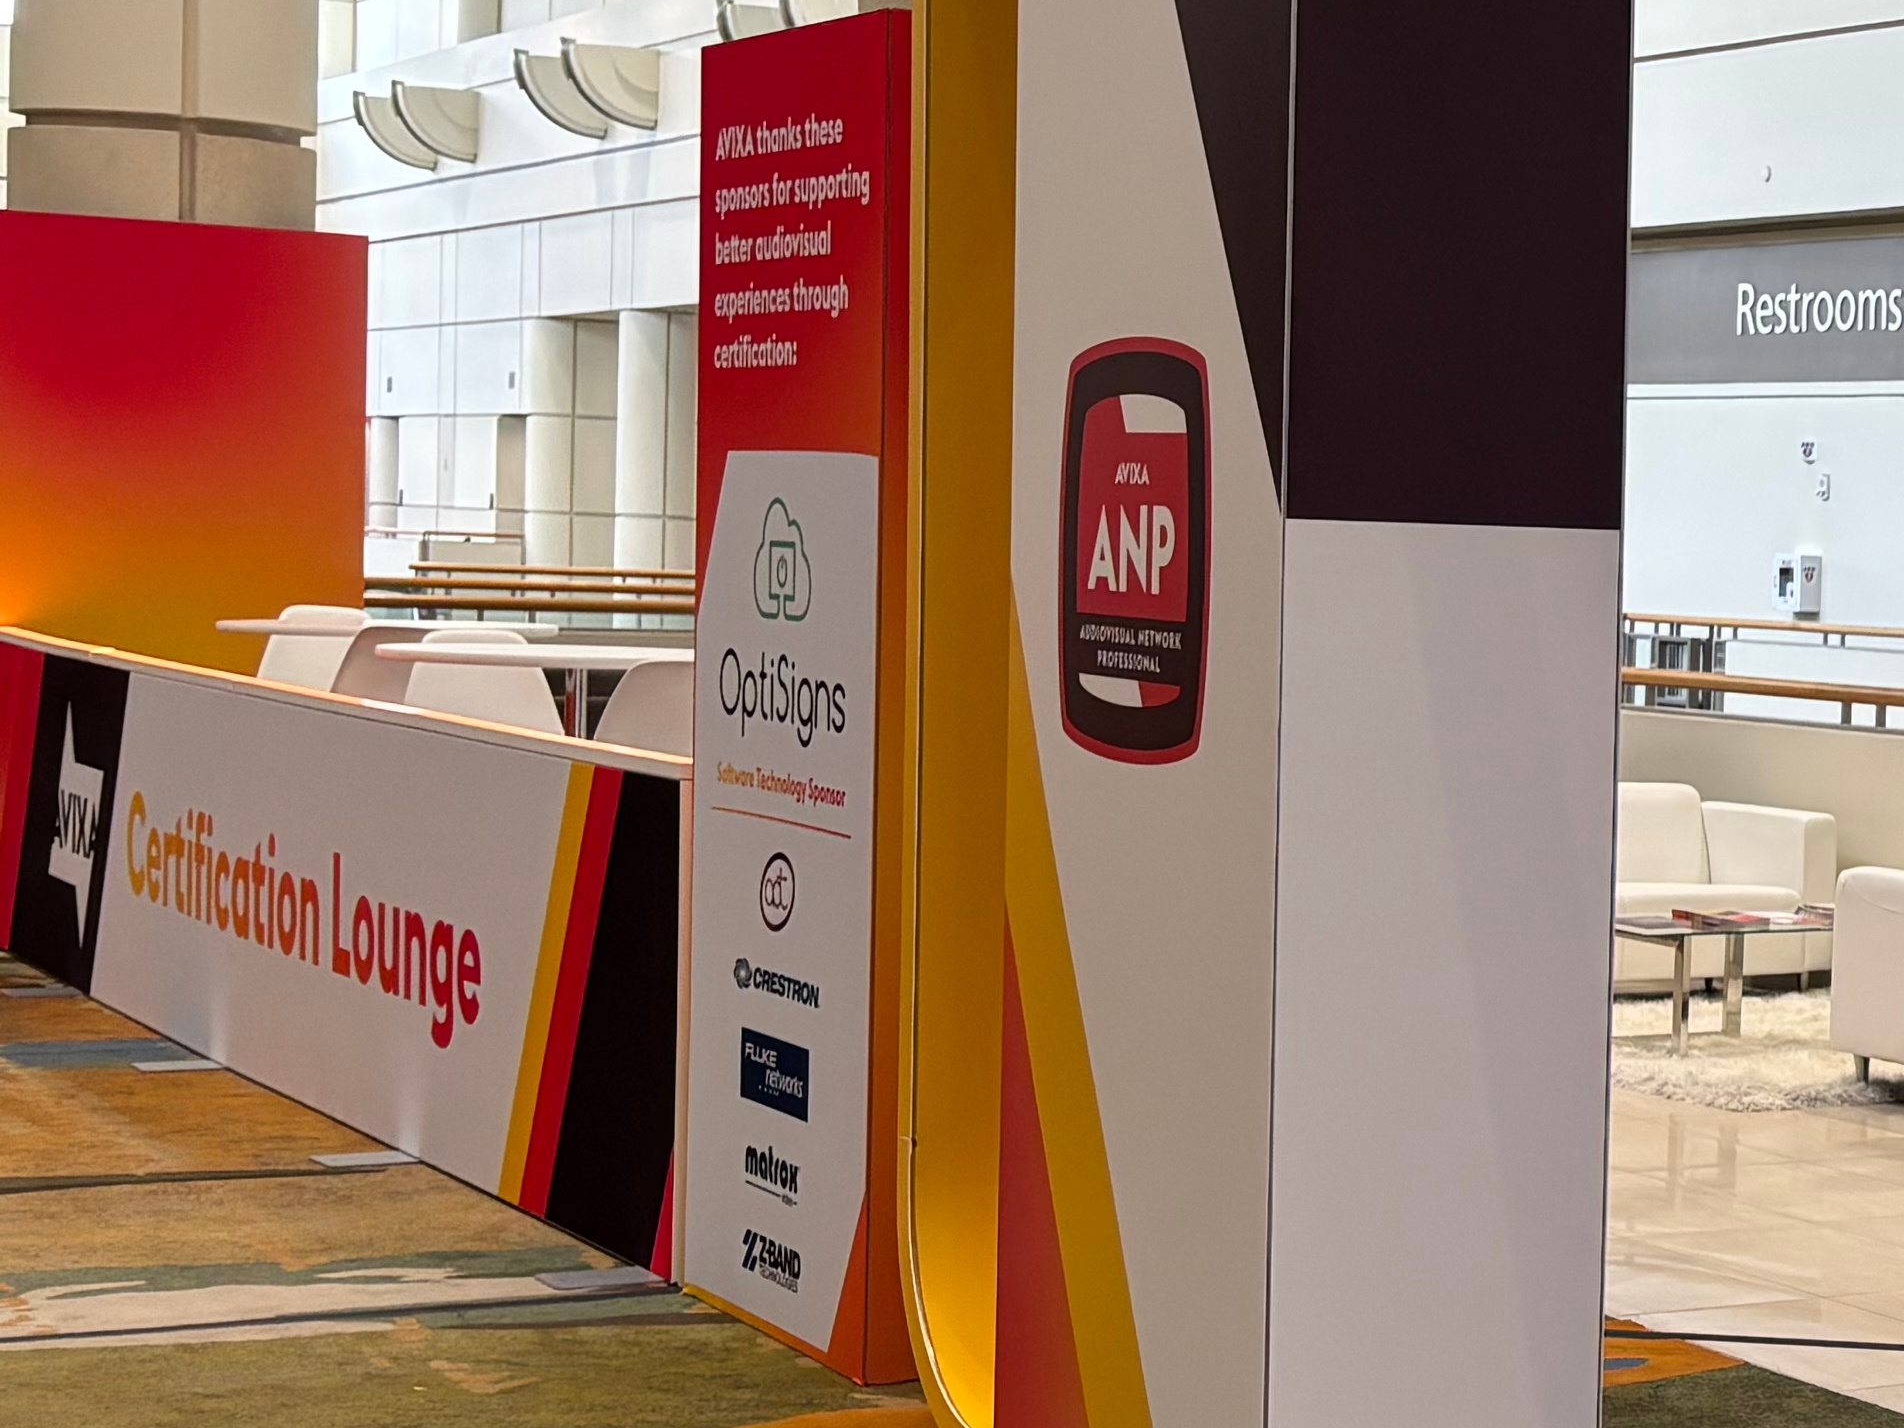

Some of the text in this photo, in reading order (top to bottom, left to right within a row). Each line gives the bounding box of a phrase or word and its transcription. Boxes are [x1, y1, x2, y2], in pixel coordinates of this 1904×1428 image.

[715, 112, 843, 161] AVIXA thanks these
[714, 163, 871, 220] sponsors for supporting
[715, 220, 831, 265] better audiovisual
[714, 275, 849, 324] experiences through
[1735, 282, 1904, 336] Restrooms
[714, 334, 798, 370] certification:
[1114, 462, 1150, 486] AVIXA
[1087, 504, 1176, 595] ANP
[1079, 624, 1182, 650] AUDIOVISUAL NETWORK
[1096, 649, 1161, 674] PROFESSIONAL
[719, 647, 847, 748] OptiSigns
[717, 761, 846, 808] Software Technology Sponsor
[52, 789, 97, 860] AVIXA
[126, 791, 482, 1049] Certification Lounge
[753, 966, 820, 1009] CRESTRON
[745, 1042, 778, 1068] FLUKE
[765, 1069, 804, 1099] networks
[745, 1145, 798, 1194] matrox
[759, 1235, 801, 1280] Z-BAND
